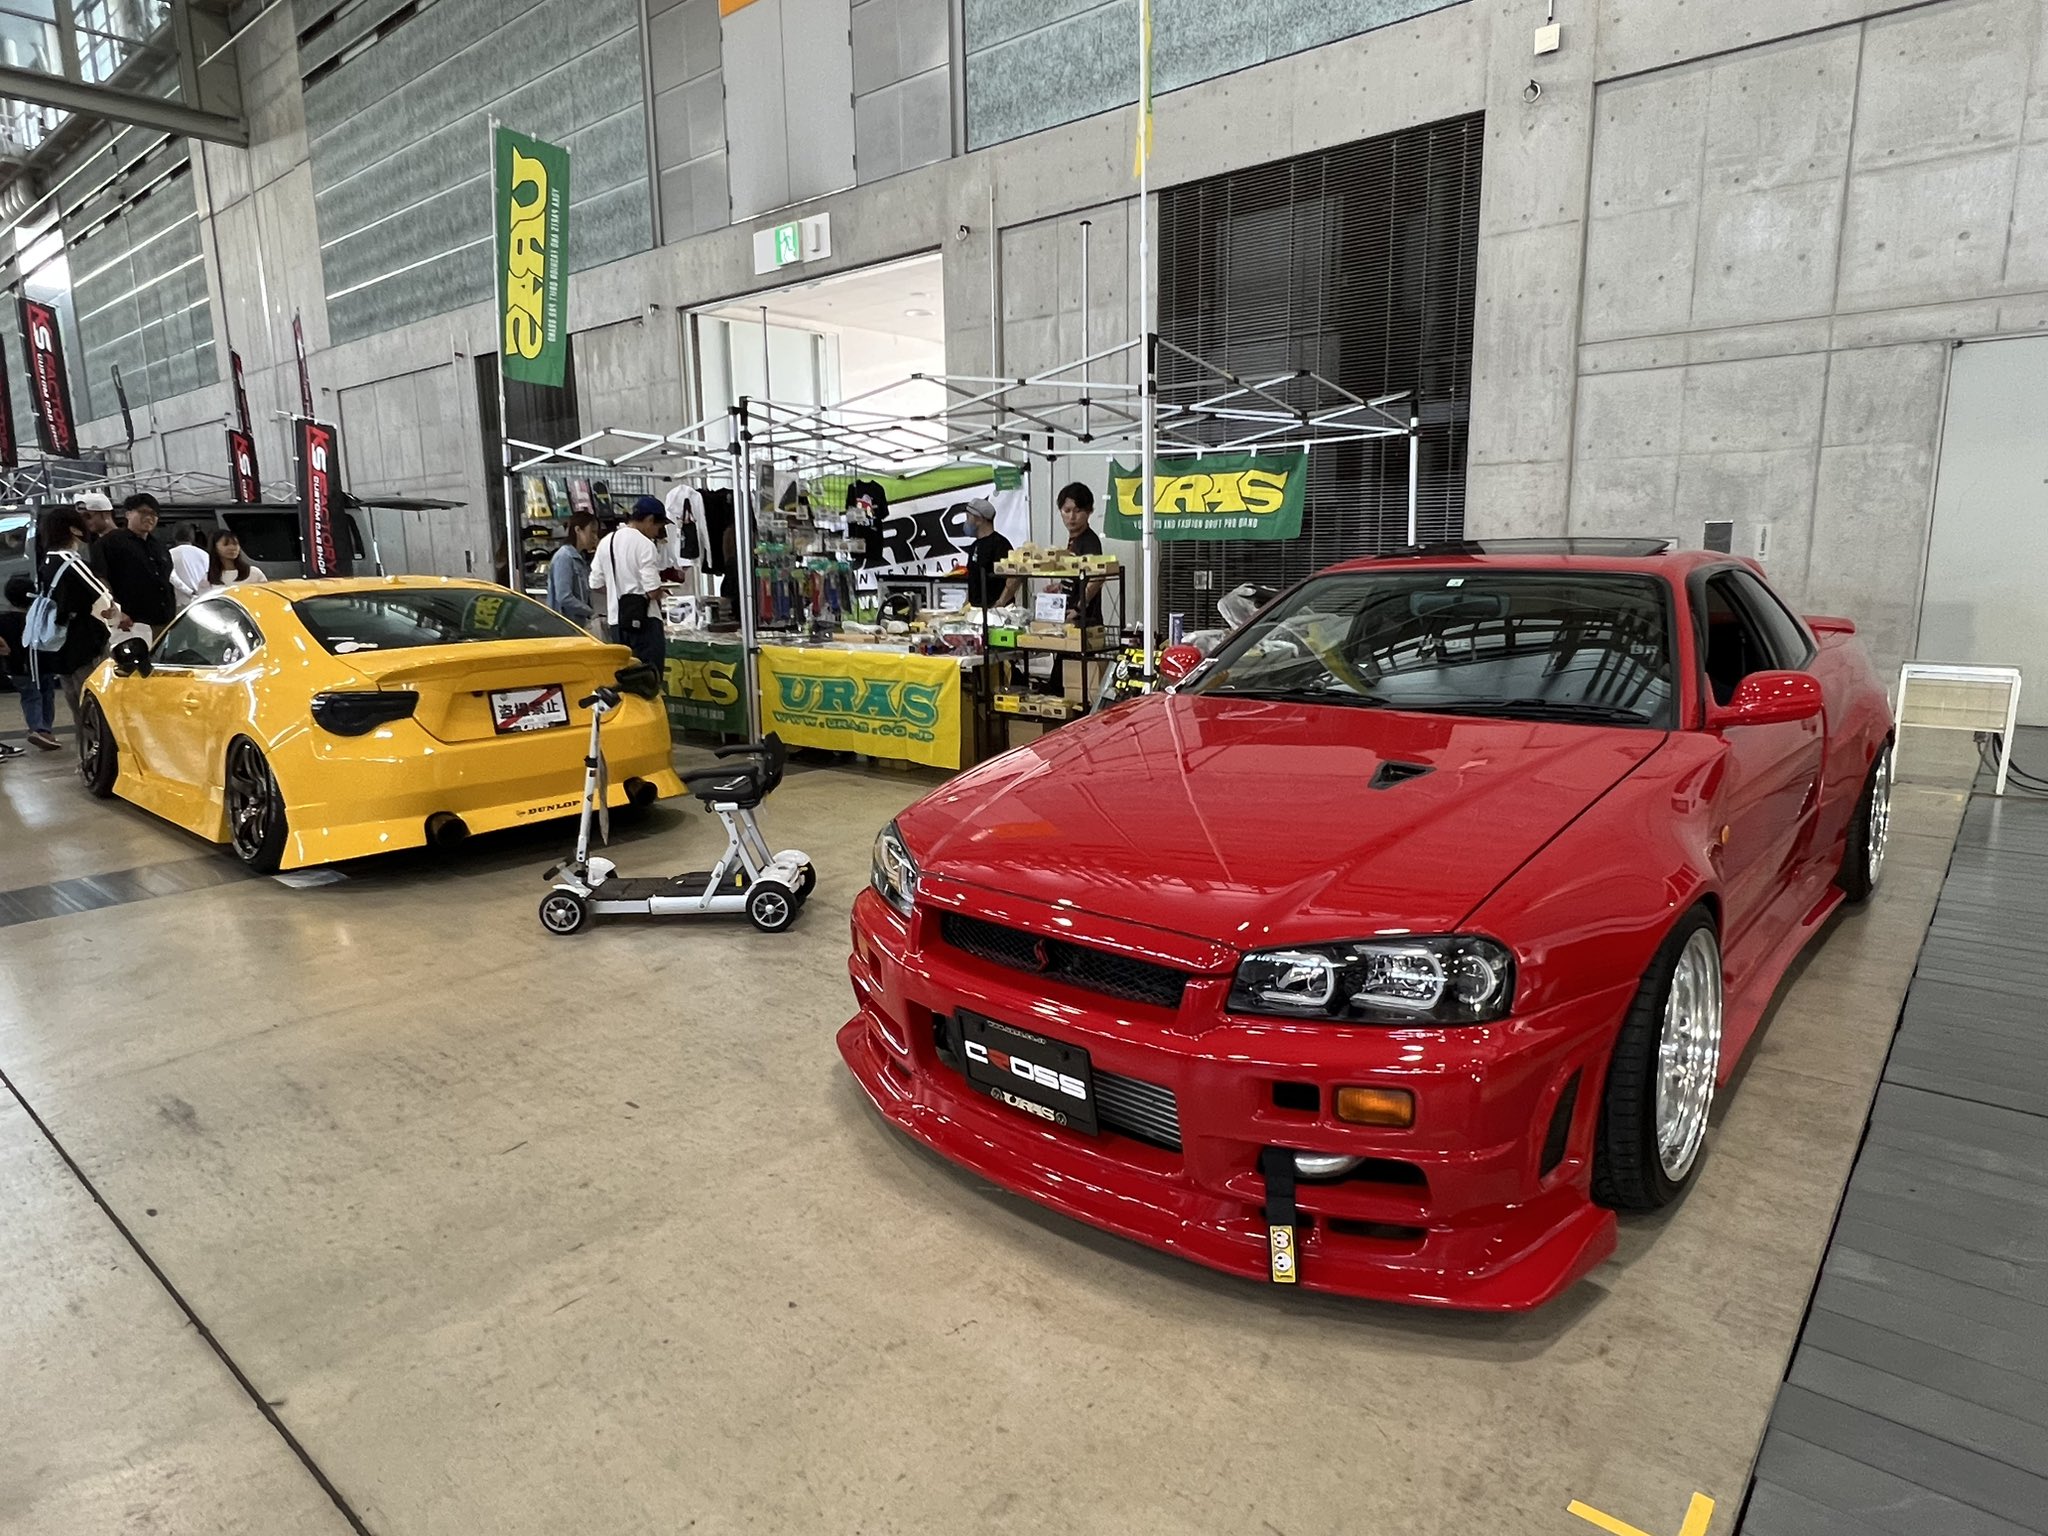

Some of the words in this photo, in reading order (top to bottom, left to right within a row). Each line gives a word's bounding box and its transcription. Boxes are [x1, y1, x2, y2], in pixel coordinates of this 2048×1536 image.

[306, 424, 331, 474] KS
[313, 475, 322, 521] CUSTOM
[1114, 469, 1288, 516] URAS
[316, 545, 327, 575] SHOP
[662, 657, 738, 706] RAS
[772, 671, 944, 729] URAS
[773, 711, 935, 743] WWW.URAS.CO.JP
[527, 800, 581, 815] DUNLOP
[1002, 1091, 1056, 1121] URAS
